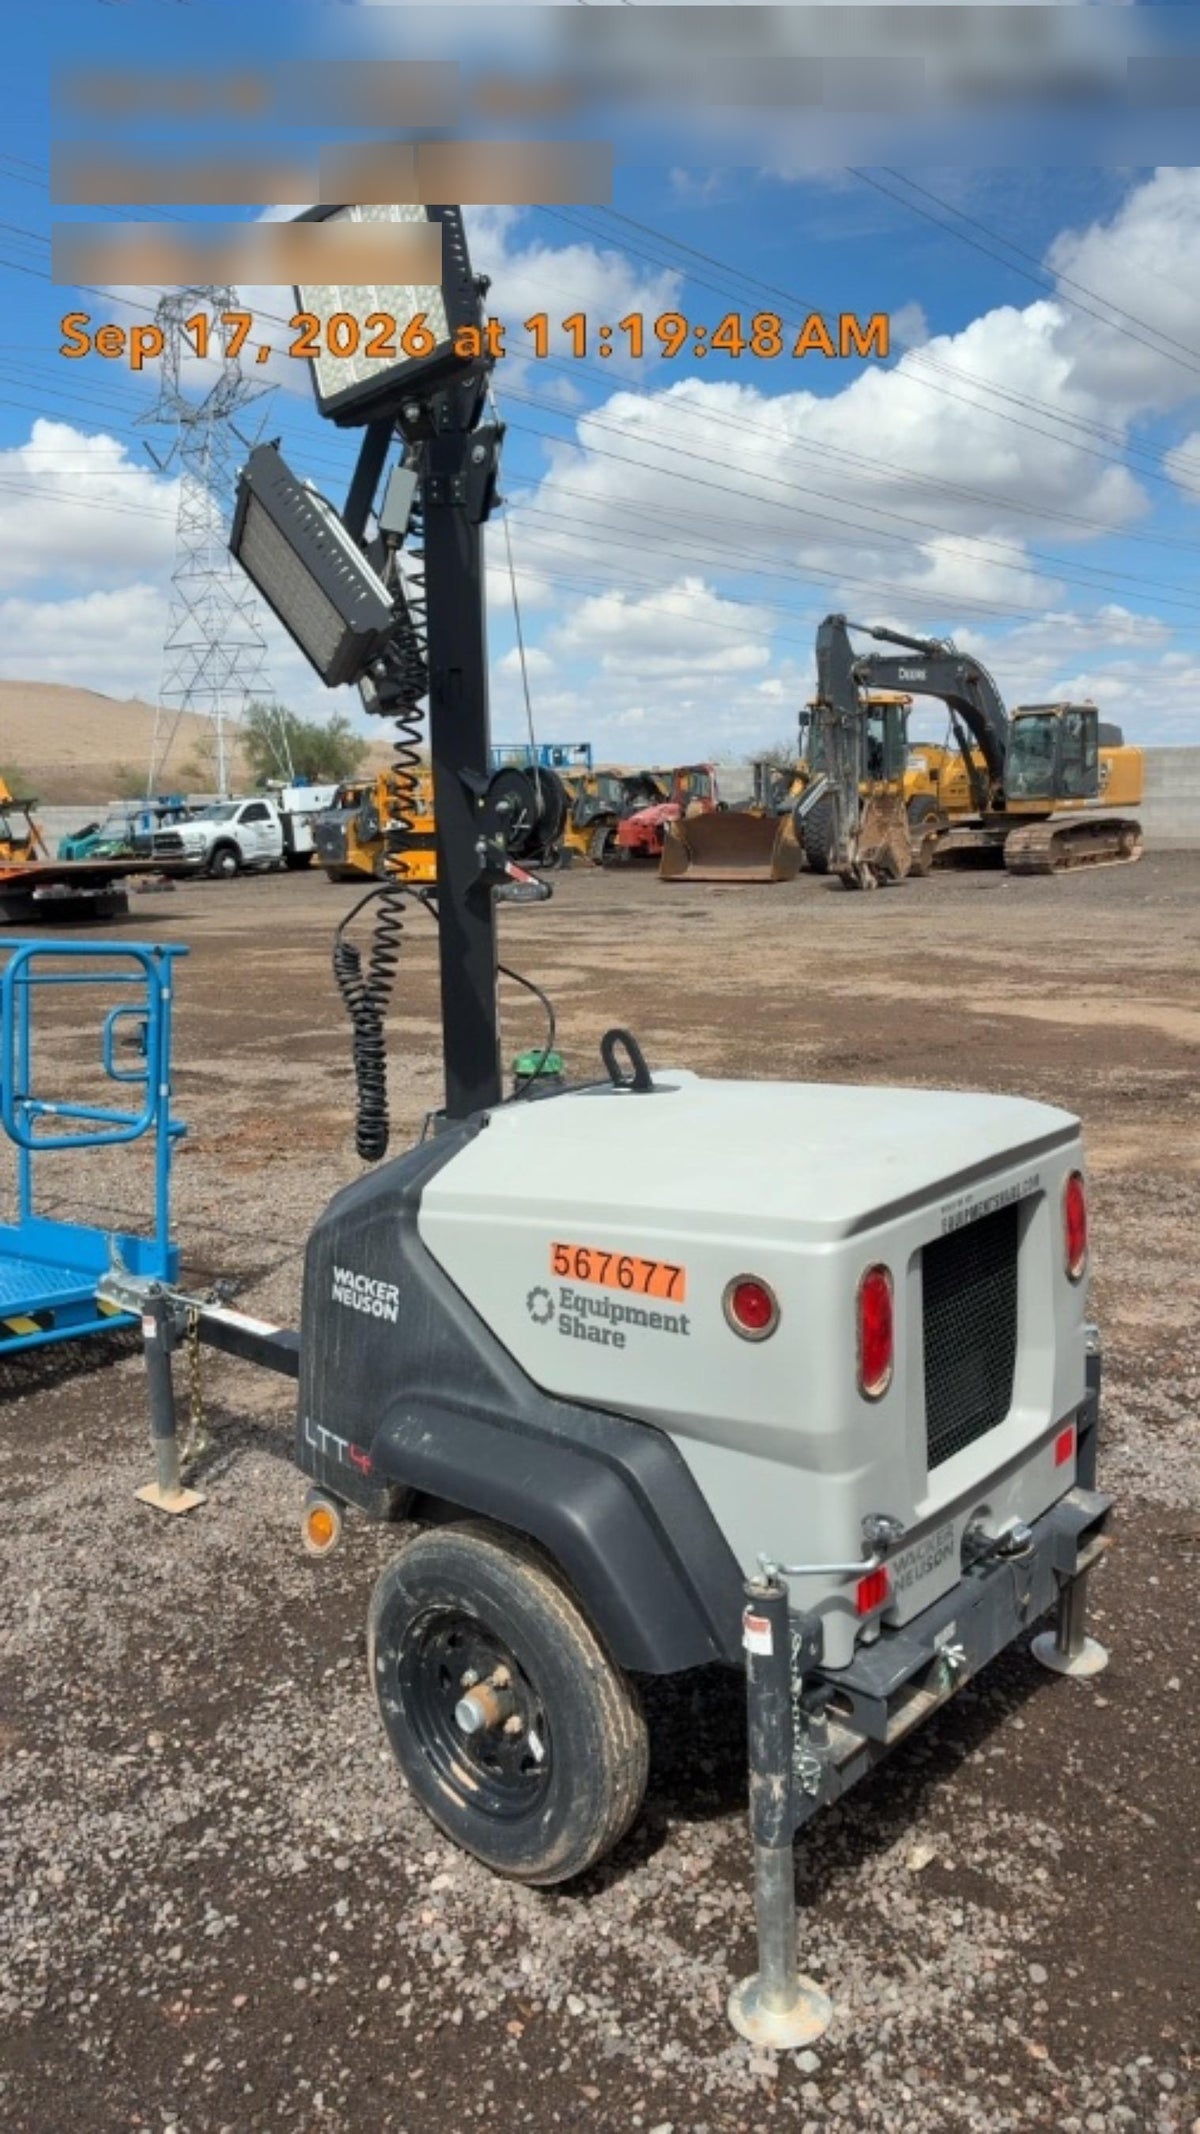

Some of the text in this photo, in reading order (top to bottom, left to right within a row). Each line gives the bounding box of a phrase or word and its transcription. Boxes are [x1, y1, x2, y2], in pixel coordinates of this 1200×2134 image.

[333, 1265, 399, 1304] WACKER
[553, 1244, 681, 1298] 567677
[332, 1284, 399, 1324] NEUSON
[559, 1286, 691, 1336] Equipment
[558, 1313, 627, 1349] Share
[305, 1416, 373, 1476] LTT4
